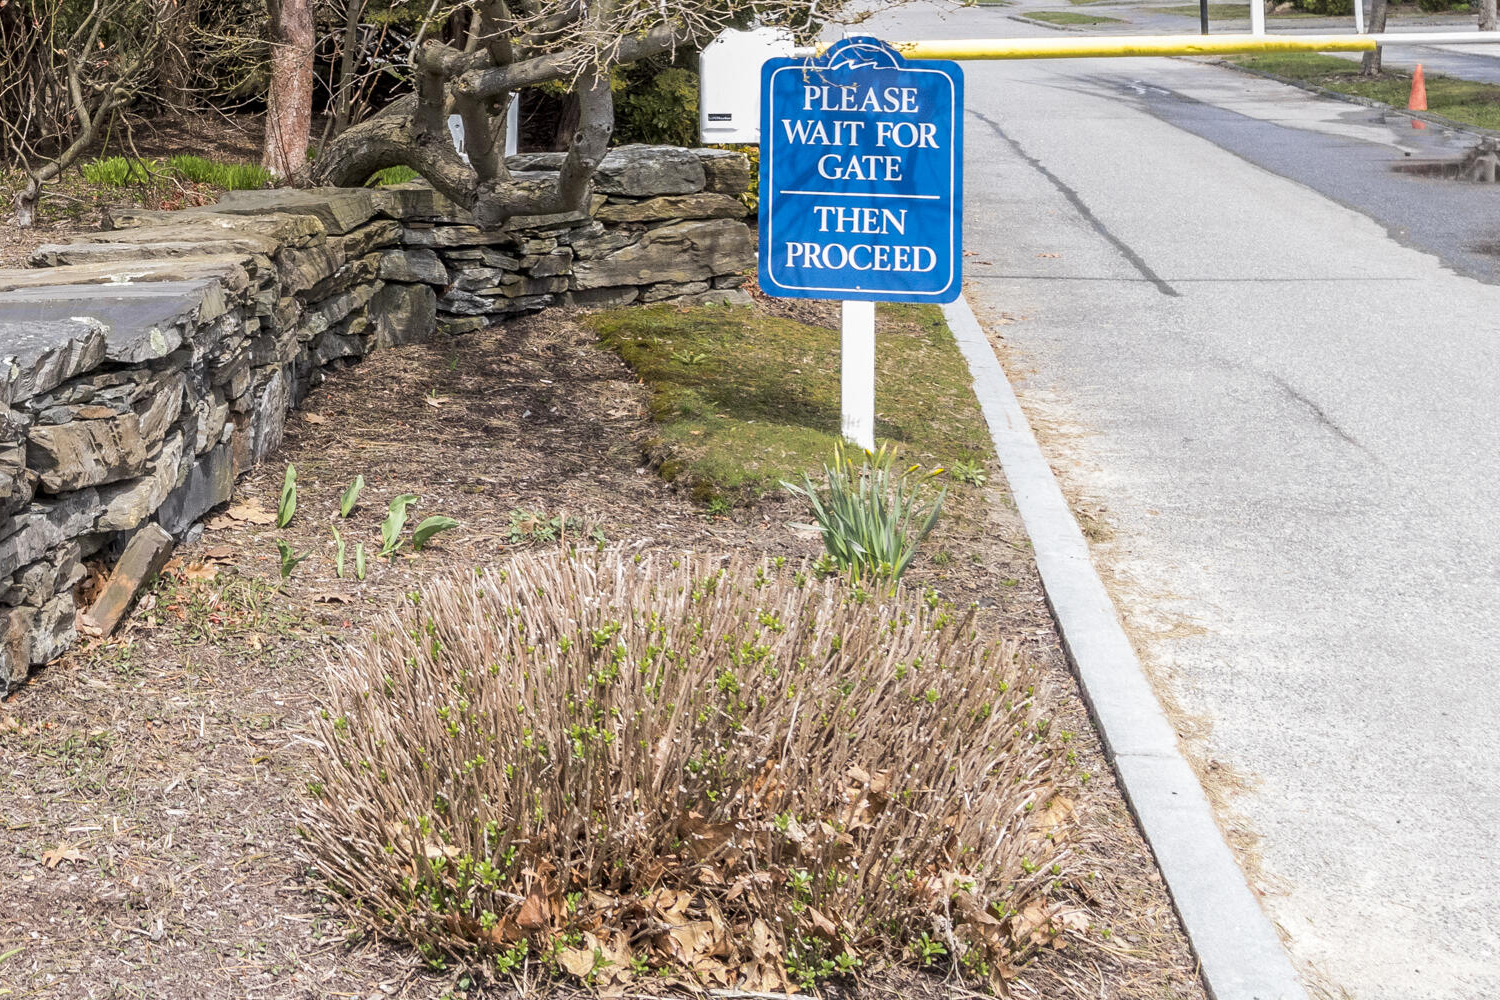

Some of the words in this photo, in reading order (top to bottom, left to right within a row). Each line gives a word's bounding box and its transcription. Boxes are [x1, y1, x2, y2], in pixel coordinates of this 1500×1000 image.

[802, 85, 919, 113] PLEASE
[781, 119, 865, 147] WAIT
[876, 121, 940, 149] FOR
[817, 154, 903, 181] GATE
[813, 206, 907, 236] THEN
[785, 241, 937, 273] PROCEED
